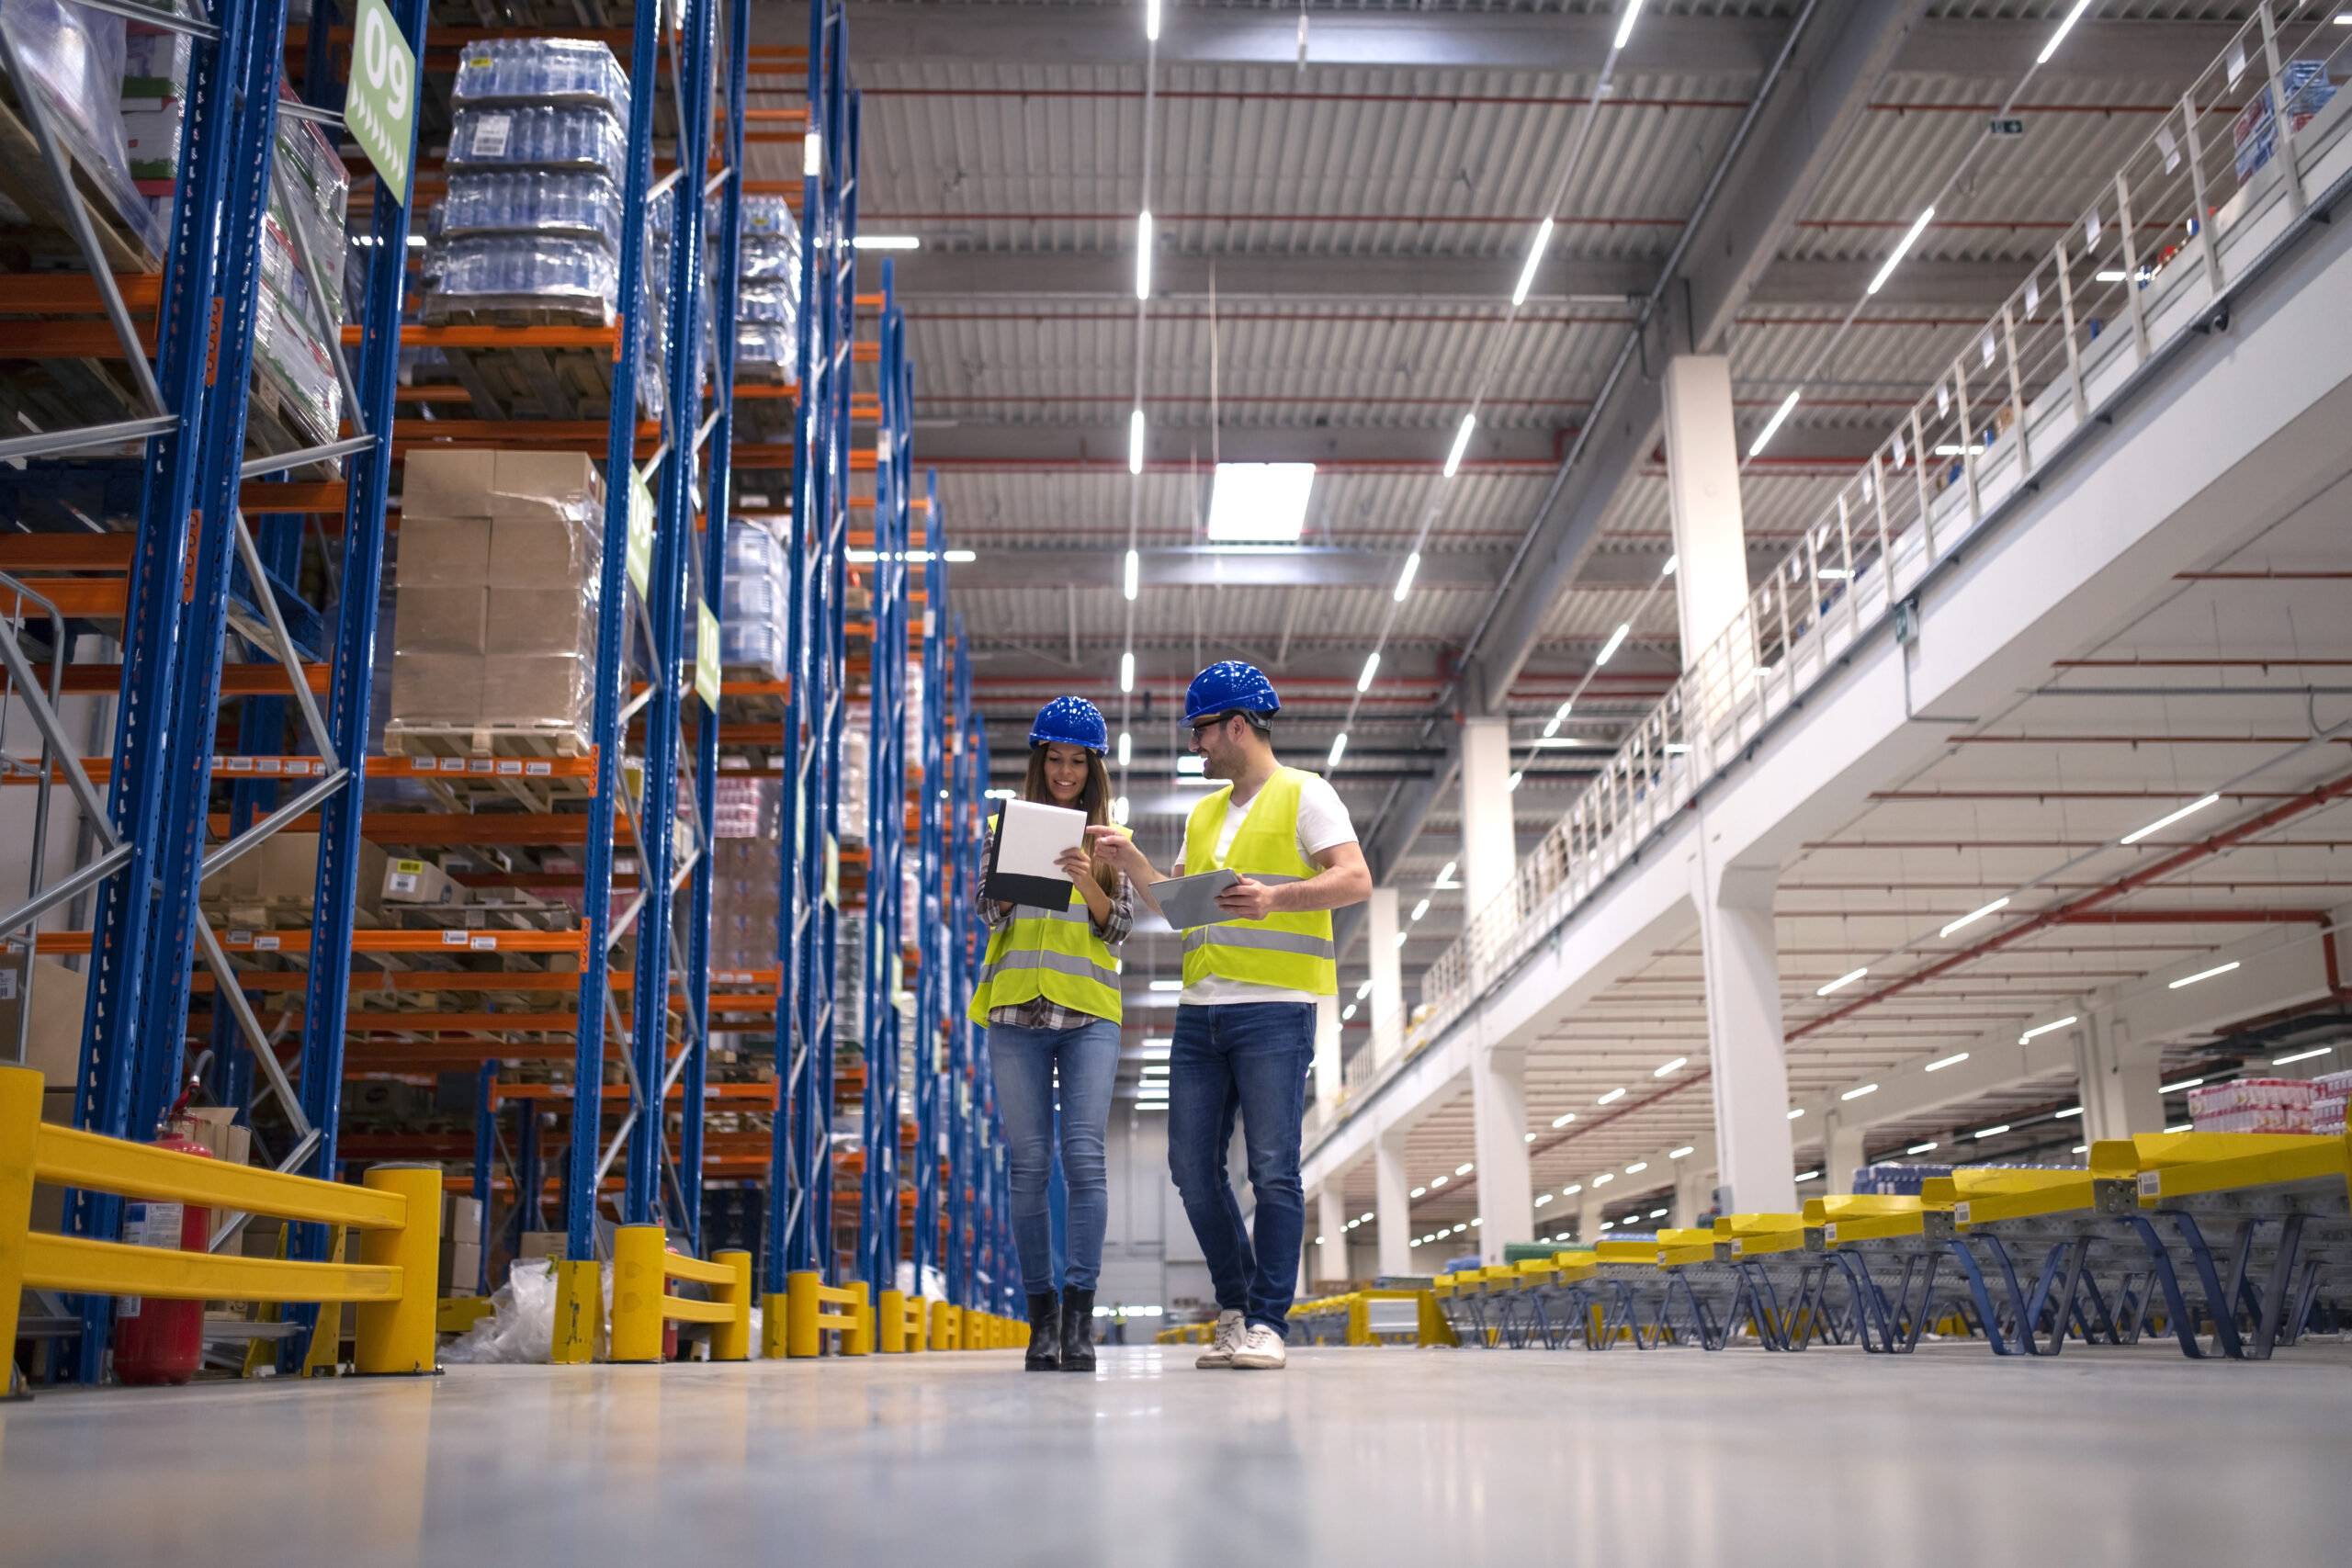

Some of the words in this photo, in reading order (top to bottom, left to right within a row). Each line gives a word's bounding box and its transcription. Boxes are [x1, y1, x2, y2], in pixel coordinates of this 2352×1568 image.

[365, 7, 408, 120] 09
[632, 483, 650, 548] 09
[702, 616, 718, 671] 10
